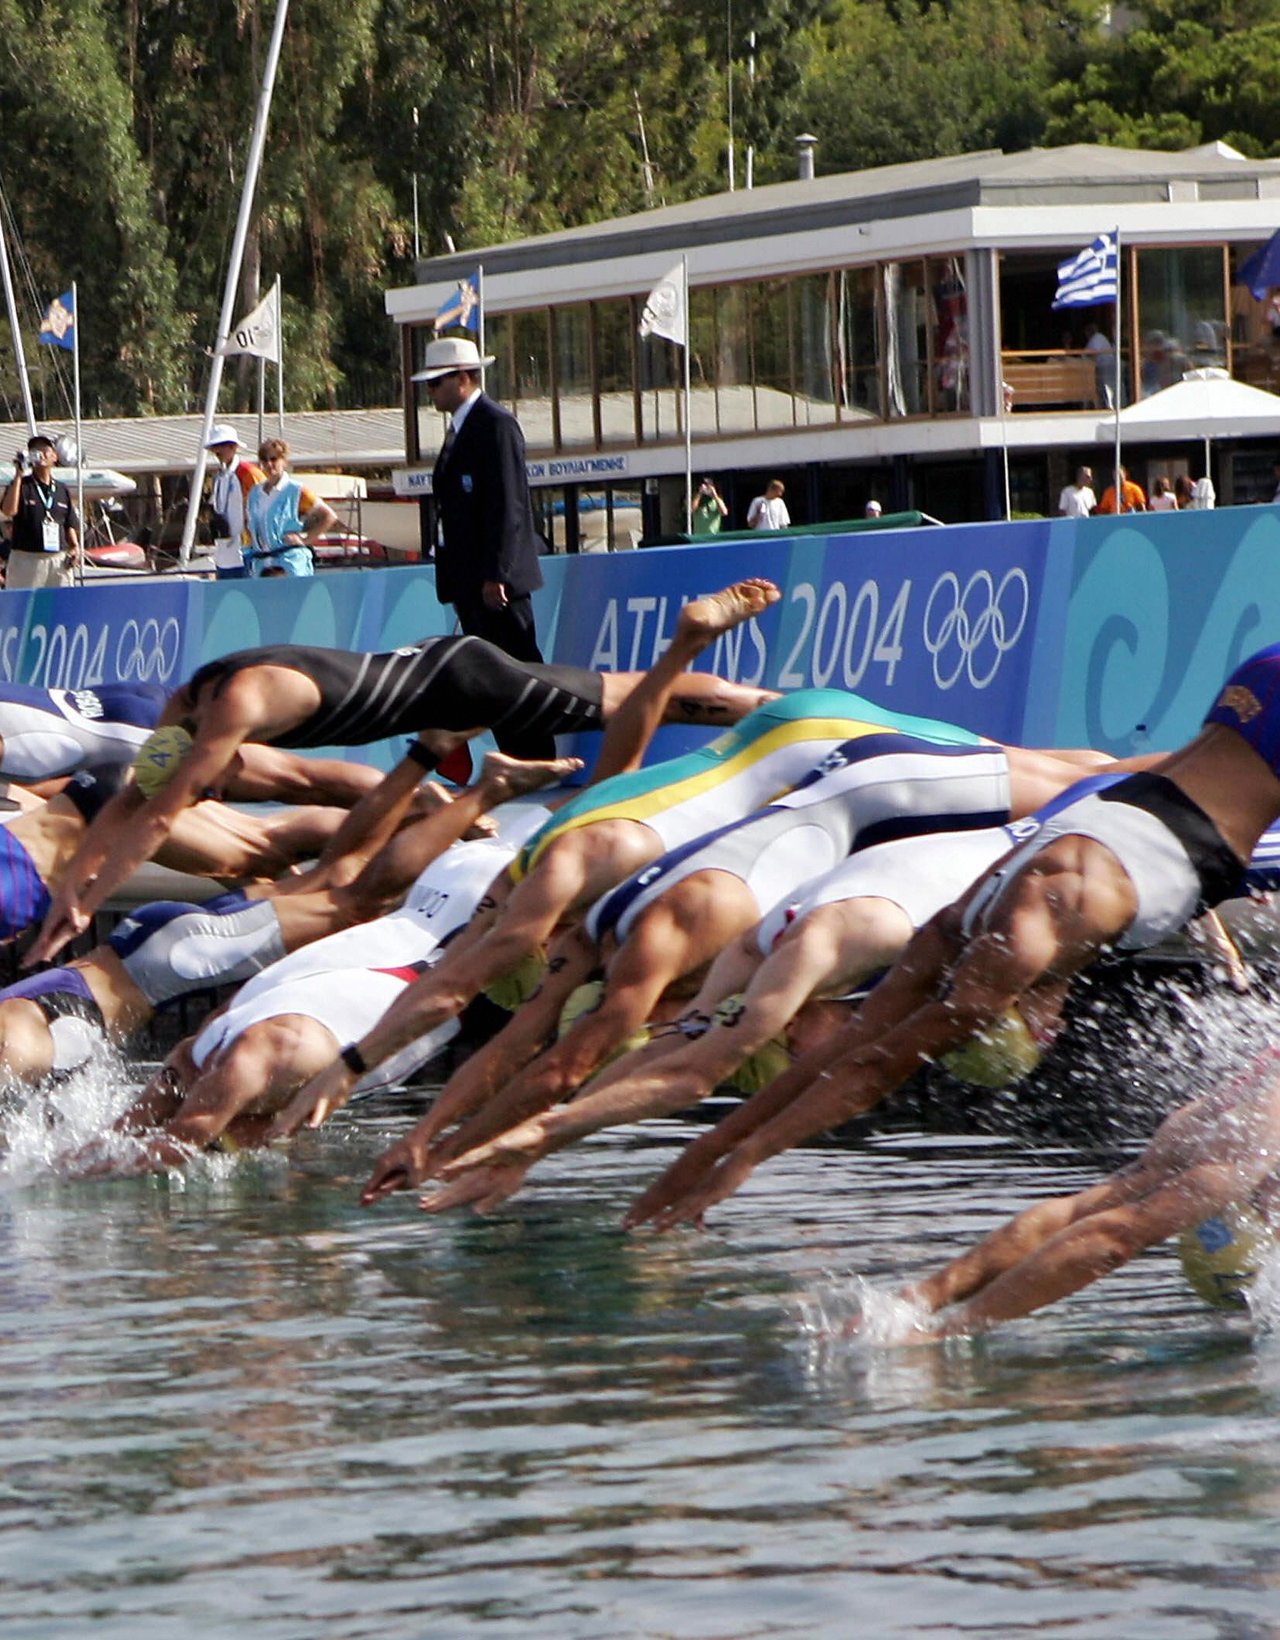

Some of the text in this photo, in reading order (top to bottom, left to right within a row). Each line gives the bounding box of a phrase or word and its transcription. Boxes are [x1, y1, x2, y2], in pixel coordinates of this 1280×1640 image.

[28, 623, 109, 690] 2004
[588, 579, 913, 688] ATHNS 2004
